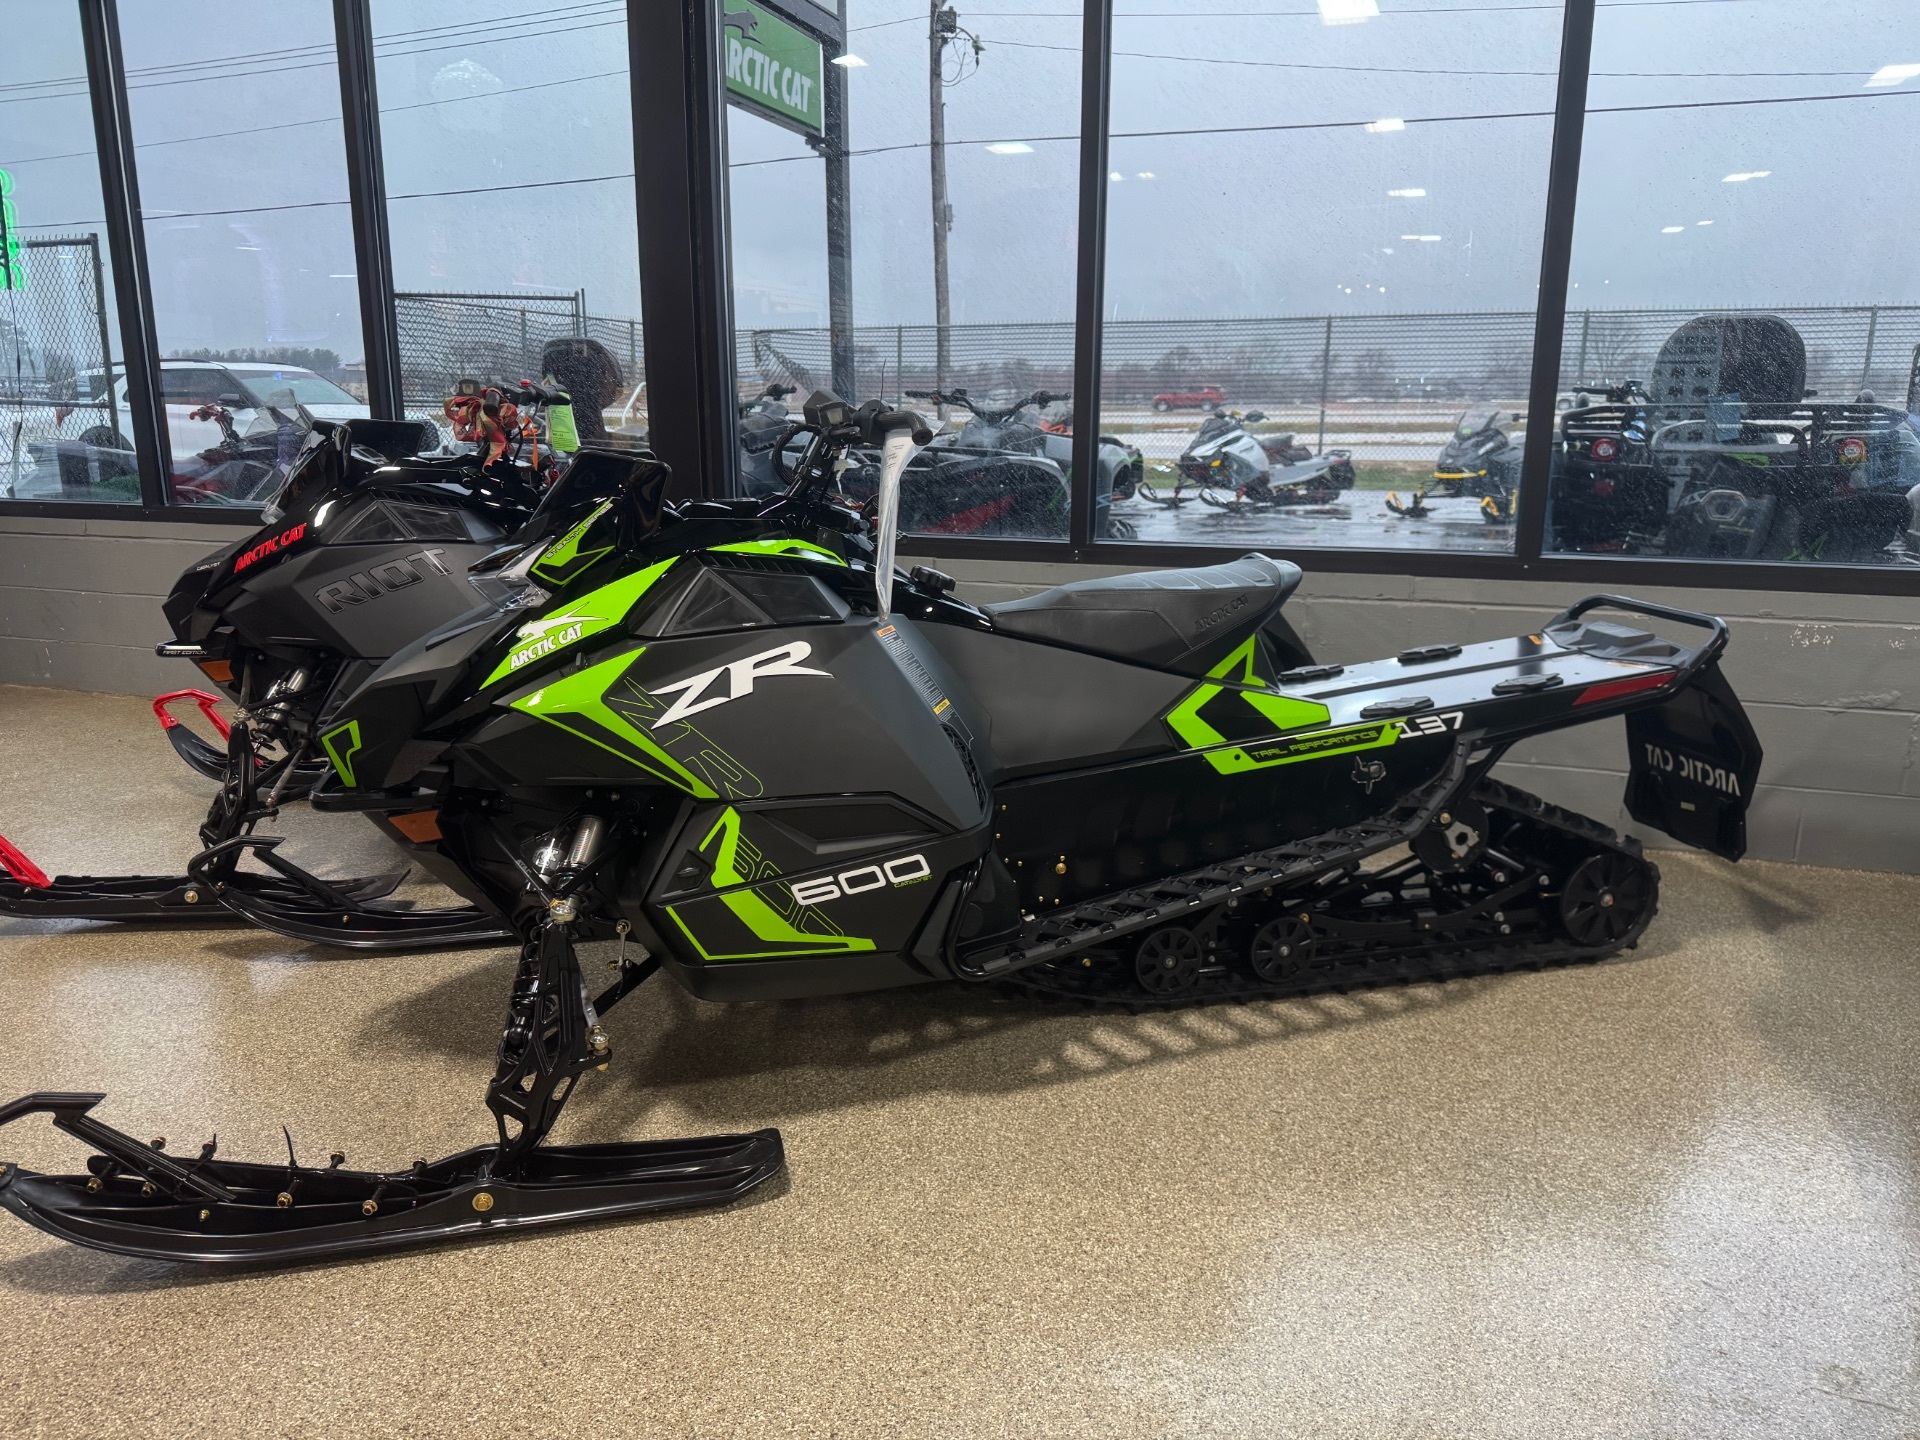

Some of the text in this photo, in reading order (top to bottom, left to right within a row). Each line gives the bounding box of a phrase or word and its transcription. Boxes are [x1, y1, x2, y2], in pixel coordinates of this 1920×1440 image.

[781, 67, 813, 113] CAT
[234, 522, 307, 574] ARCTIC CAT
[545, 503, 614, 559] STEALTH SERIES
[313, 548, 453, 614] RIOT
[1194, 593, 1249, 634] ARCTIC CAT
[510, 622, 584, 671] ARCTIC CAT
[648, 640, 834, 730] ZR
[1251, 730, 1379, 759] TRAIL PERFORMANCE
[1395, 711, 1464, 739] 137
[790, 854, 931, 906] 600
[893, 874, 933, 888] CATALYST
